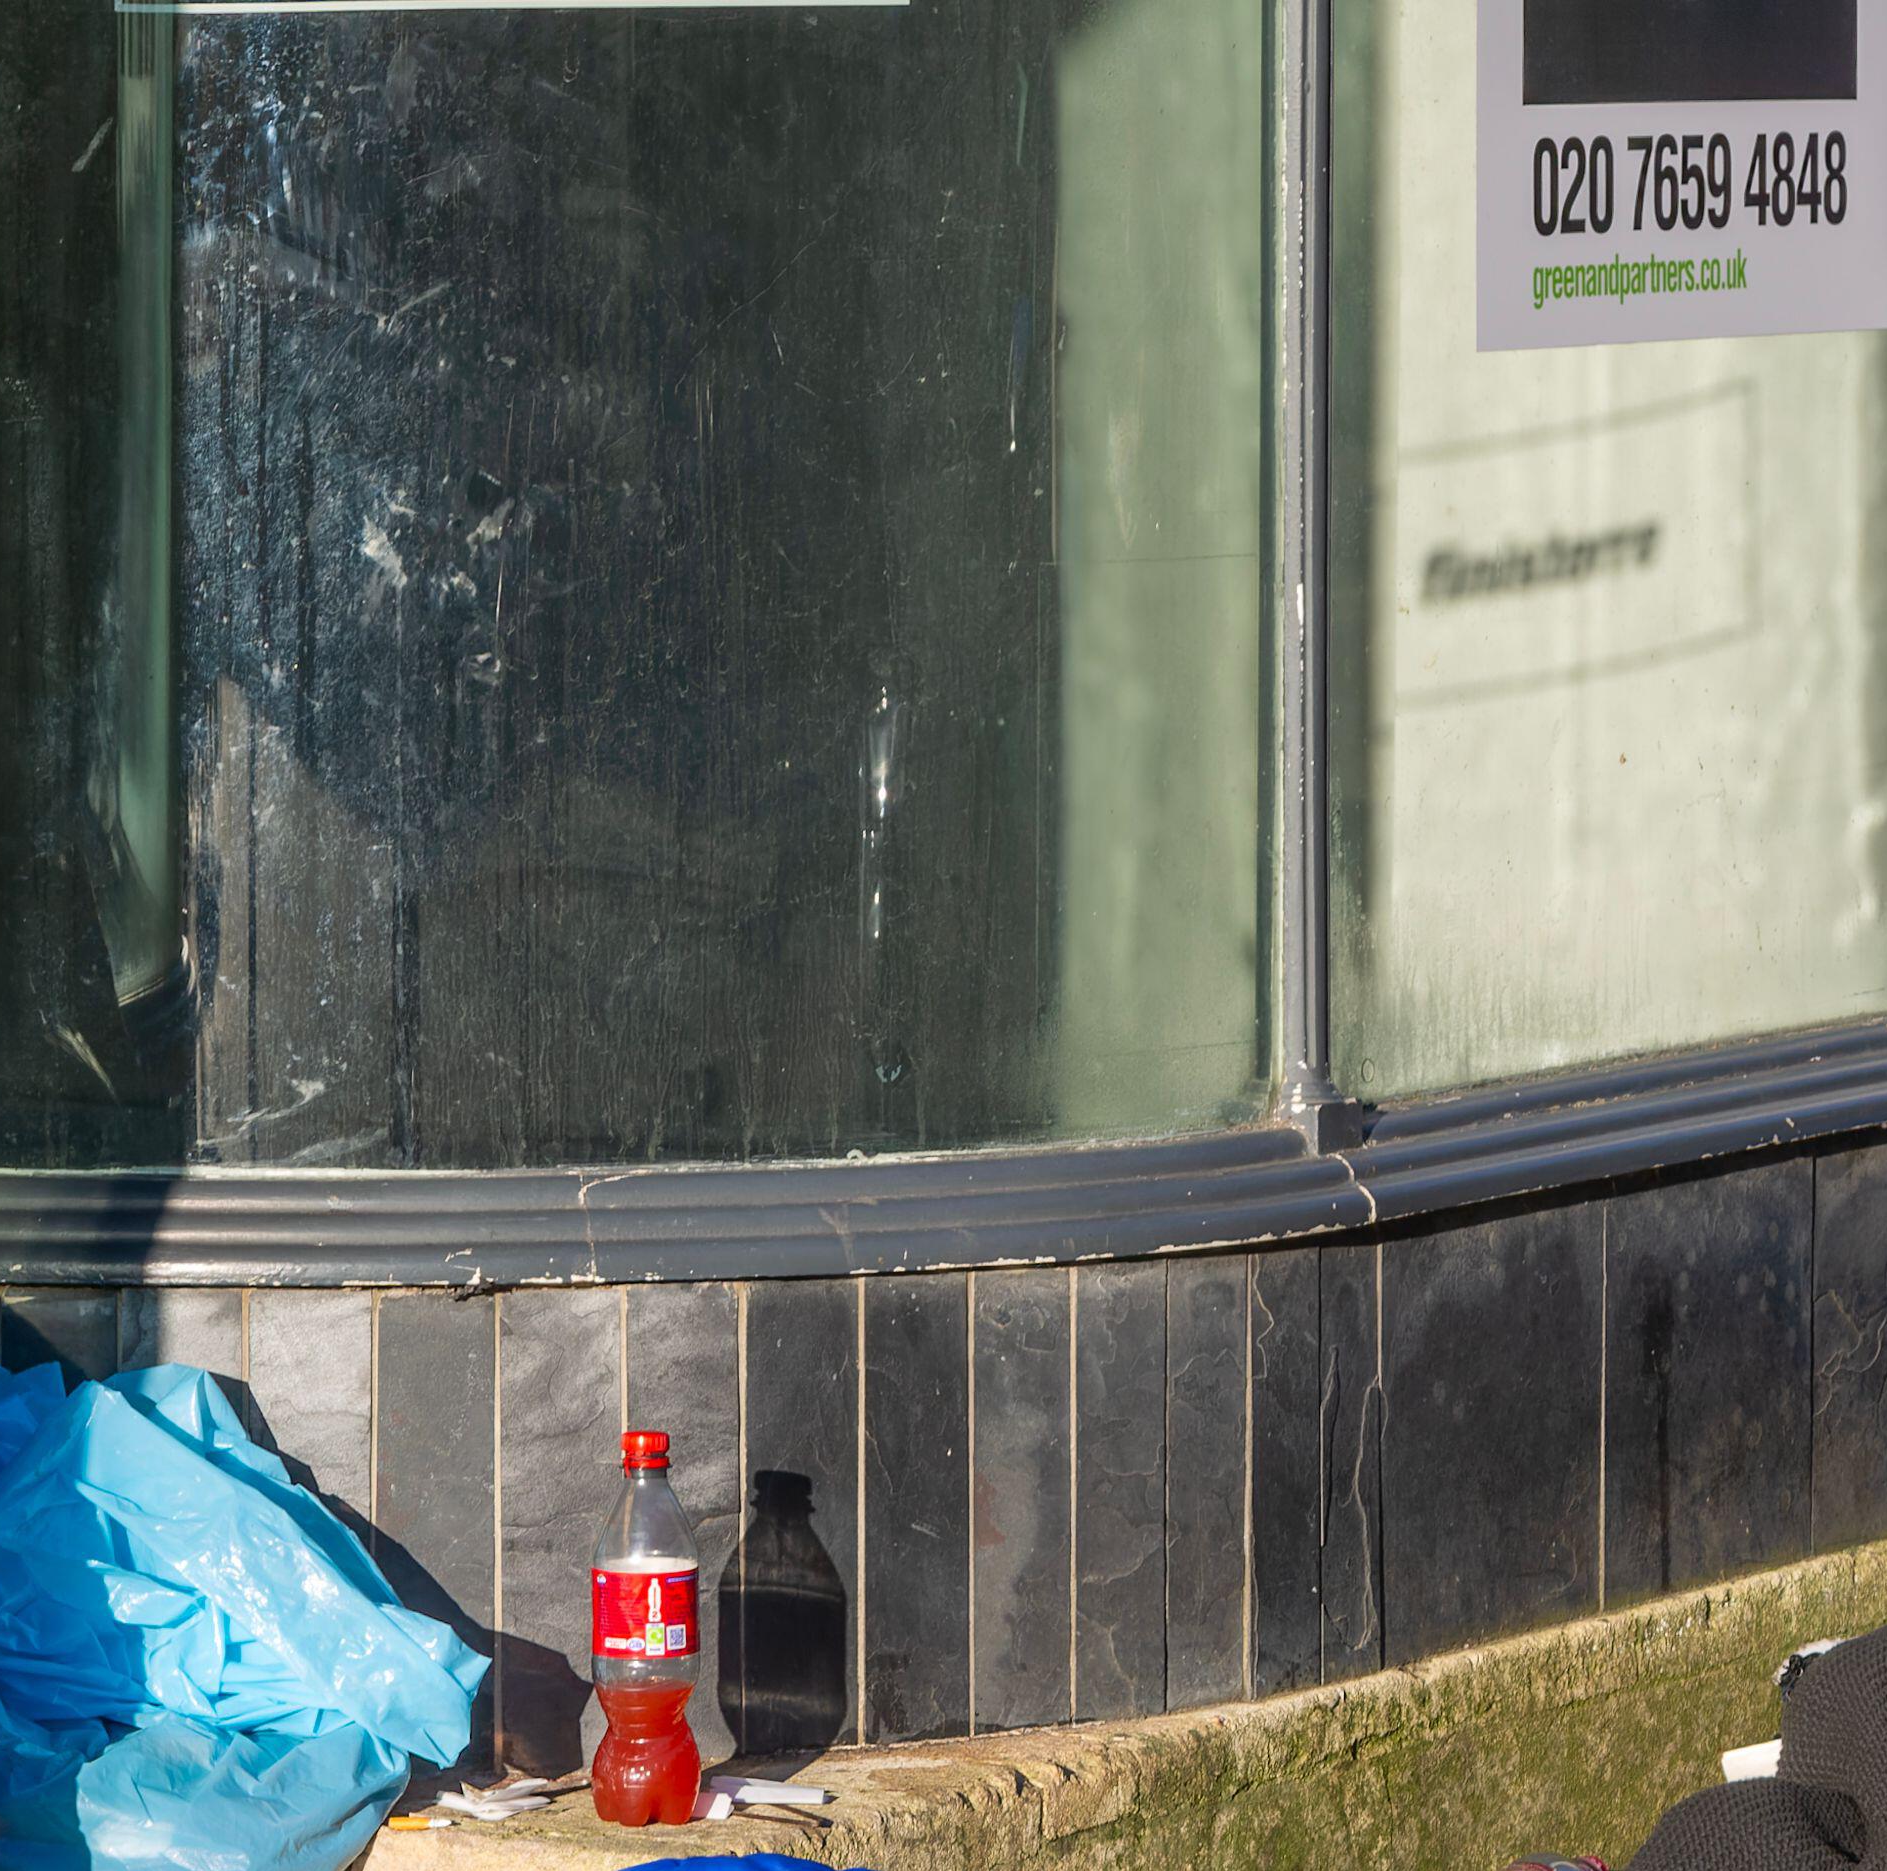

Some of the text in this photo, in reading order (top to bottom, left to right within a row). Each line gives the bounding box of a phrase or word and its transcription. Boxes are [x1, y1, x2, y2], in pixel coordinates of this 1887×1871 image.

[1533, 130, 1848, 236] 020 7659 4848
[1532, 248, 1747, 310] greenandpartners.co.uk
